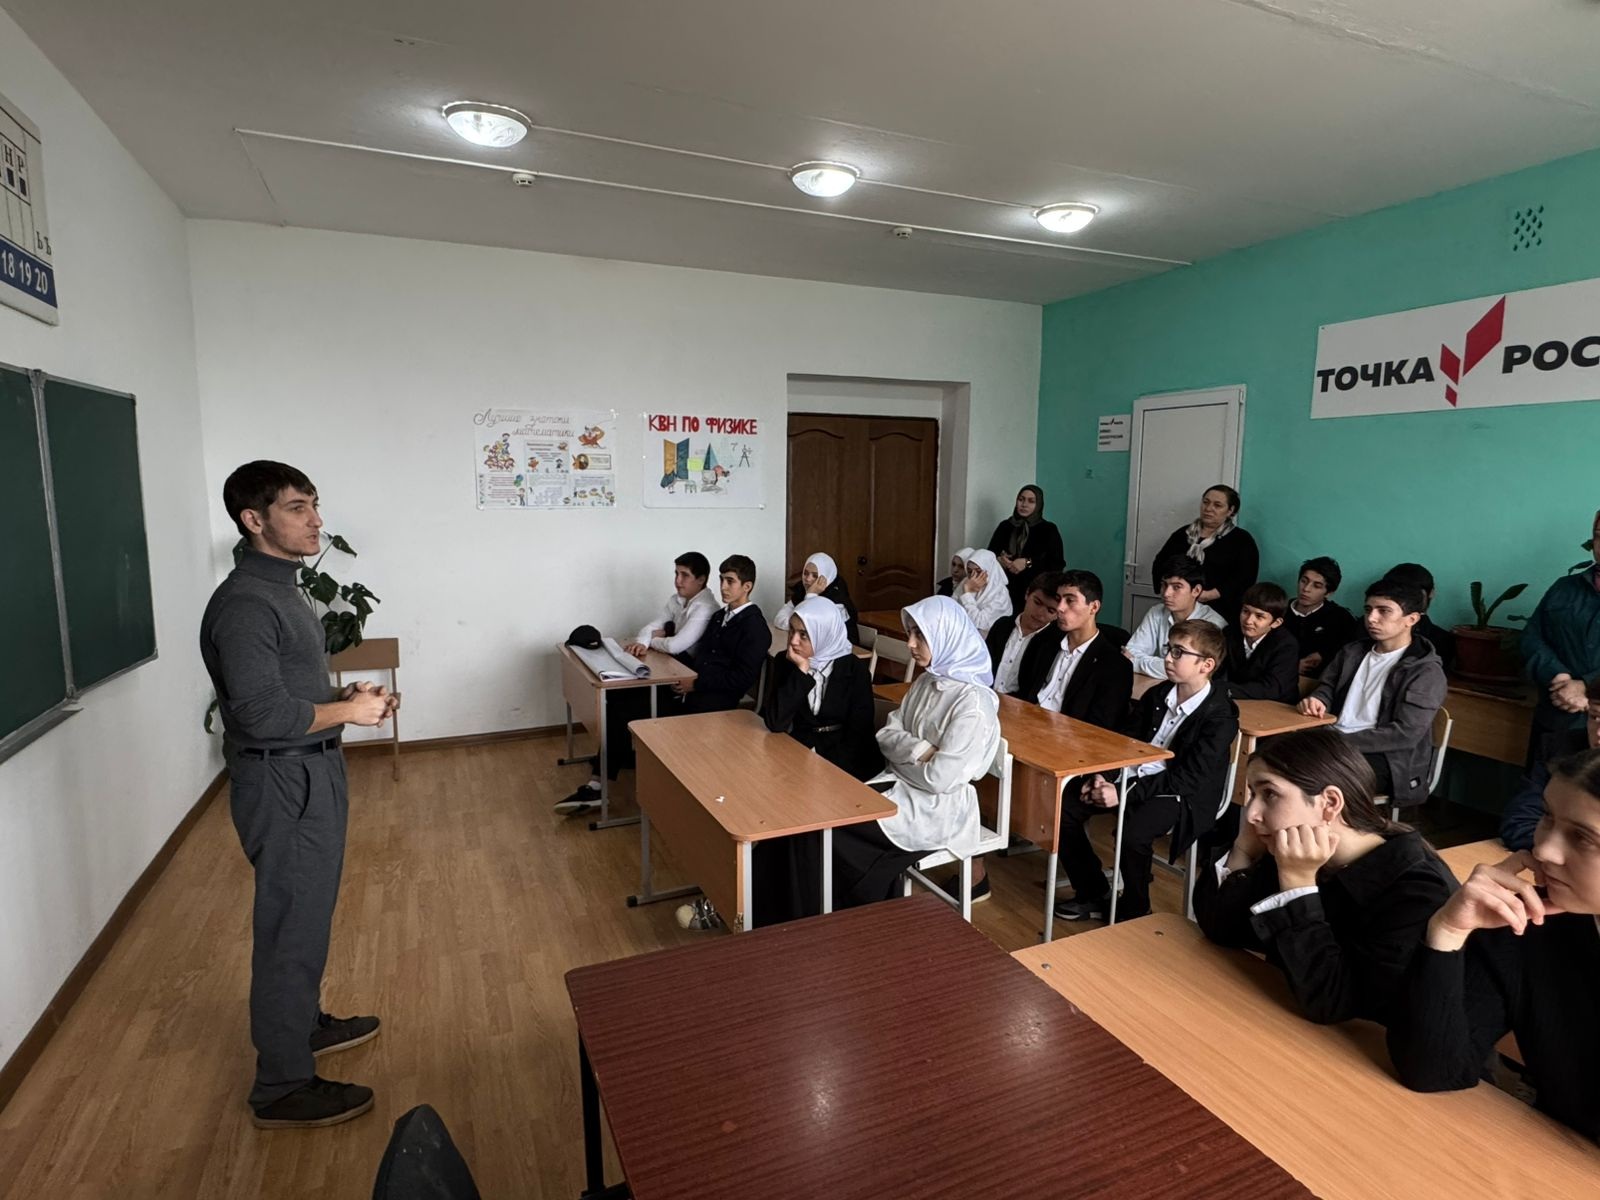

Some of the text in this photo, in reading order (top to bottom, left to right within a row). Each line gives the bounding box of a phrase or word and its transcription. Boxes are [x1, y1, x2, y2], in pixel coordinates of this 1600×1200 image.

[1, 249, 48, 295] 18 19 20
[1316, 335, 1600, 393] ТОЧКА РОС
[648, 414, 758, 435] КВН ПО ФИЗИКЕ
